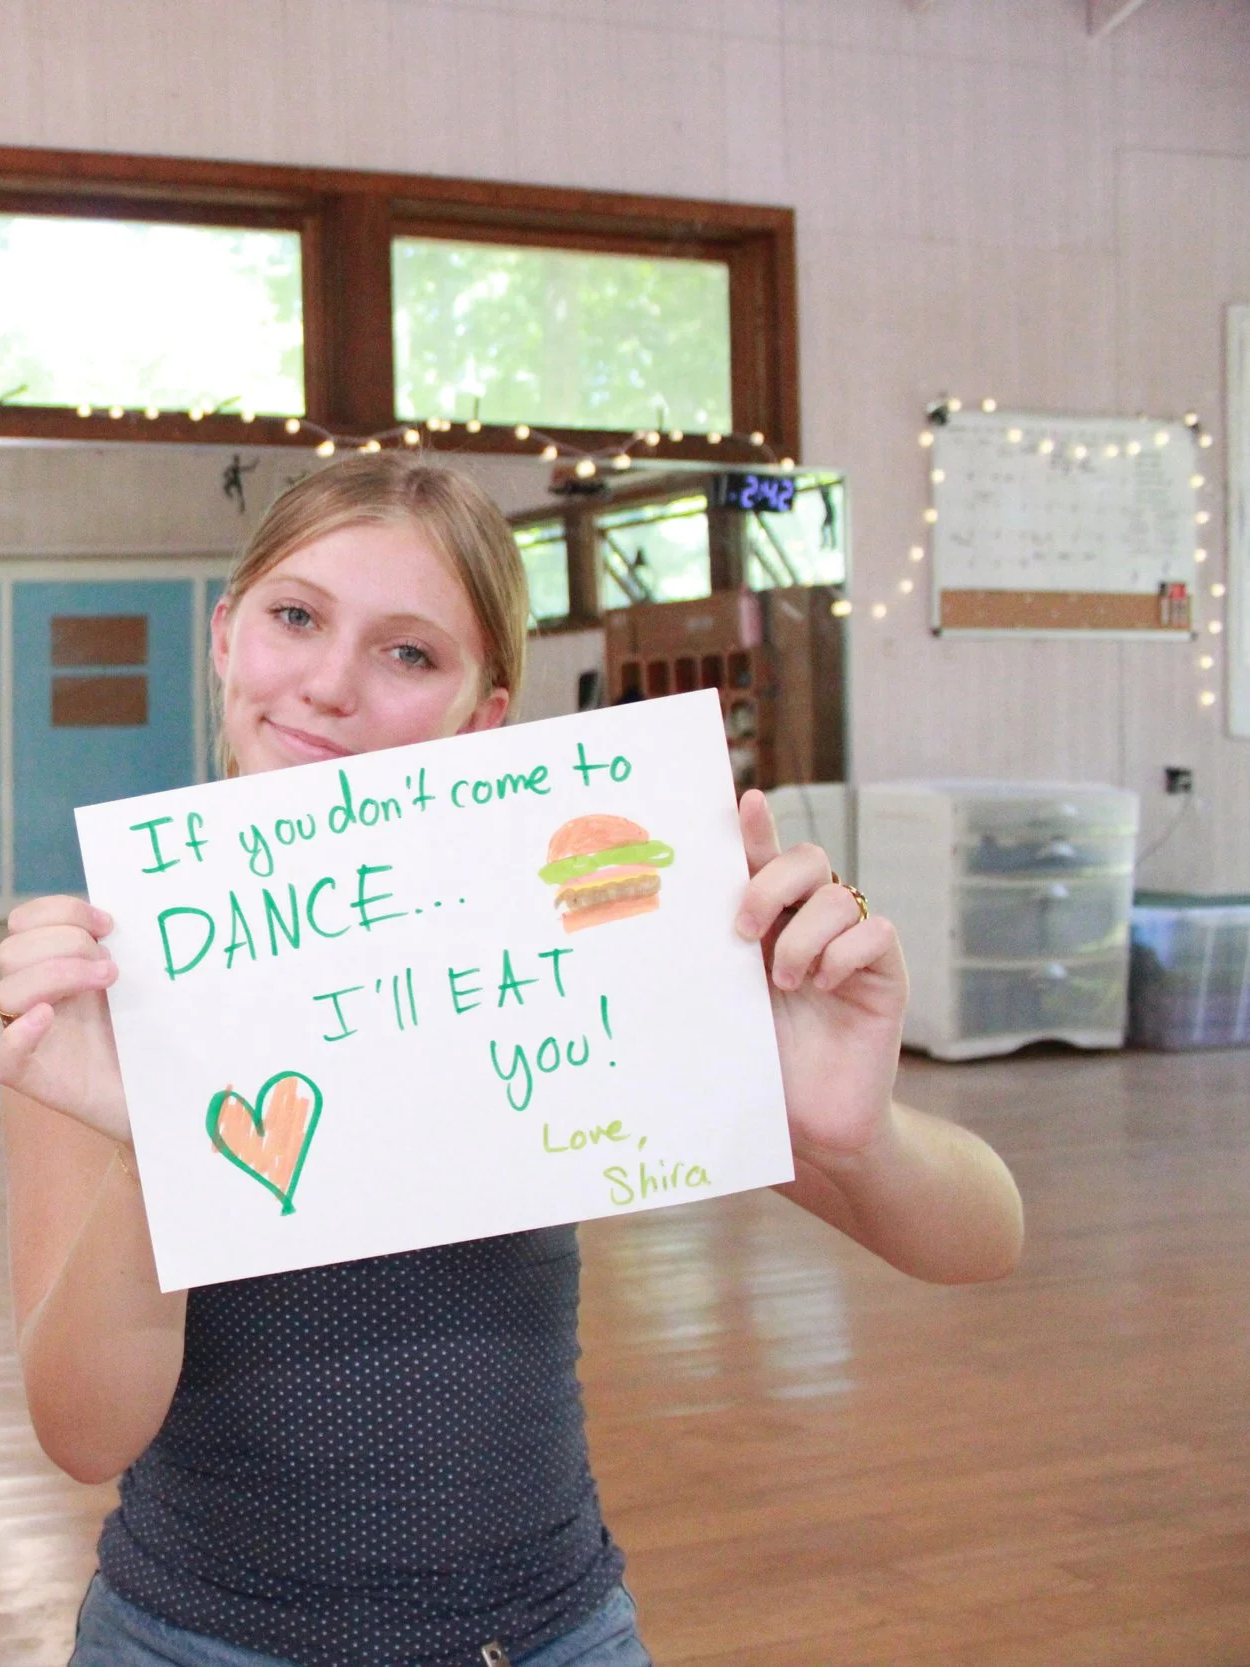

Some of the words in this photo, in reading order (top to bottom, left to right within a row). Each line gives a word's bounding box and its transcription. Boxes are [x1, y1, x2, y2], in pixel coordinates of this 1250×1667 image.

[129, 811, 207, 874] If
[238, 815, 317, 878] you
[328, 768, 434, 834] don't
[450, 764, 551, 808] come
[573, 742, 633, 787] to
[157, 863, 467, 981] DANCE...
[312, 966, 419, 1042] I'll
[447, 948, 574, 1015] EAT
[543, 1118, 648, 1155] Love,
[603, 1160, 712, 1206] Shira
